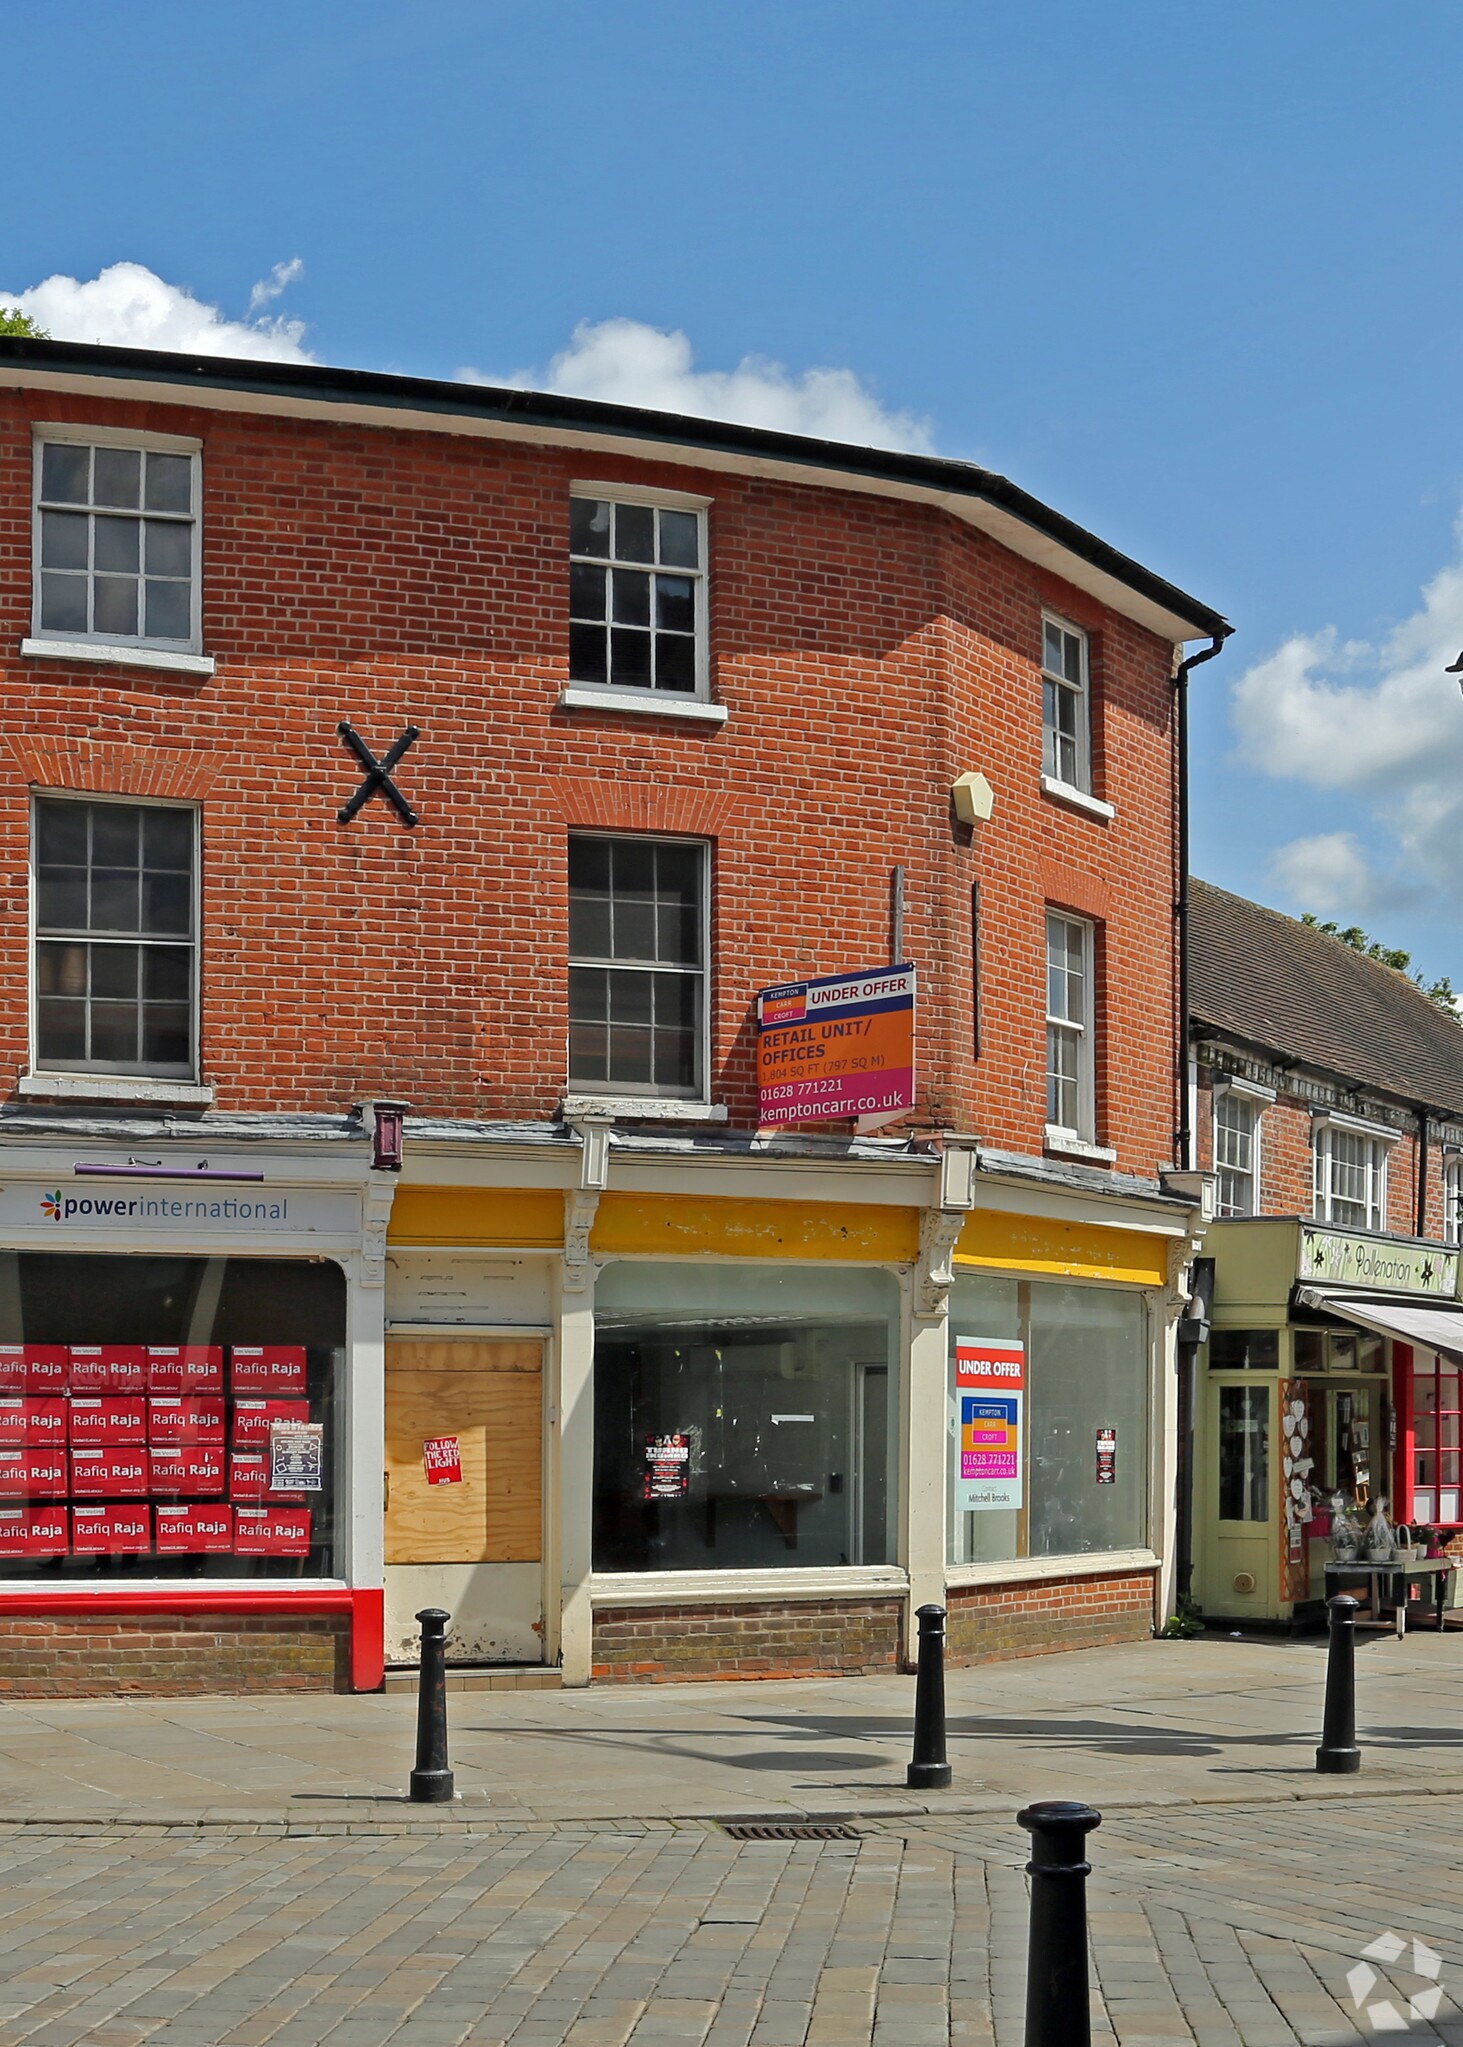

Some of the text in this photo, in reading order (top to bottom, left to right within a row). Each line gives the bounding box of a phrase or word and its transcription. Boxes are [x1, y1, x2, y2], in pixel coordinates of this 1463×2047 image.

[770, 989, 799, 998] KEMPTON
[812, 978, 906, 1004] UNDER OFFER
[776, 1000, 792, 1008] CARR
[773, 1011, 793, 1020] CROFT
[763, 1019, 872, 1048] RETAIL UNIT/
[762, 1044, 825, 1066] OFFICES
[790, 1066, 804, 1077] SQ
[808, 1063, 820, 1074] FT
[851, 1057, 867, 1069] SQ
[761, 1079, 843, 1101] 01628 771221
[760, 1090, 903, 1122] kemptoncarr.co.uk
[31, 1362, 62, 1376] Raja
[73, 1363, 140, 1376] Rafiq Raja
[151, 1363, 217, 1376] Rafiq Raja
[235, 1363, 301, 1376] Rafiq Raja
[959, 1359, 1021, 1377] UNDER OFFER
[31, 1414, 61, 1429] Raja
[73, 1415, 141, 1428] Rafiq Raja
[152, 1413, 219, 1427] Rafiq Raja
[238, 1416, 270, 1429] Rafiq
[424, 1440, 458, 1450] FOLLOW
[425, 1449, 460, 1459] THE RED
[963, 1454, 1015, 1465] 01628 771221
[428, 1457, 458, 1469] LIGHT
[31, 1467, 61, 1480] Raja
[74, 1465, 142, 1479] Rafiq Raja
[152, 1464, 219, 1477] Rafiq Raja
[234, 1470, 266, 1483] Rafiq
[963, 1466, 1015, 1477] kemptoncarr.co.uk
[992, 1492, 1010, 1502] Brooks
[32, 1525, 63, 1538] Raja
[77, 1522, 145, 1536] Rafiq Raja
[160, 1521, 227, 1535] Rafiq Raja
[239, 1524, 305, 1538] Rafiq Raja
